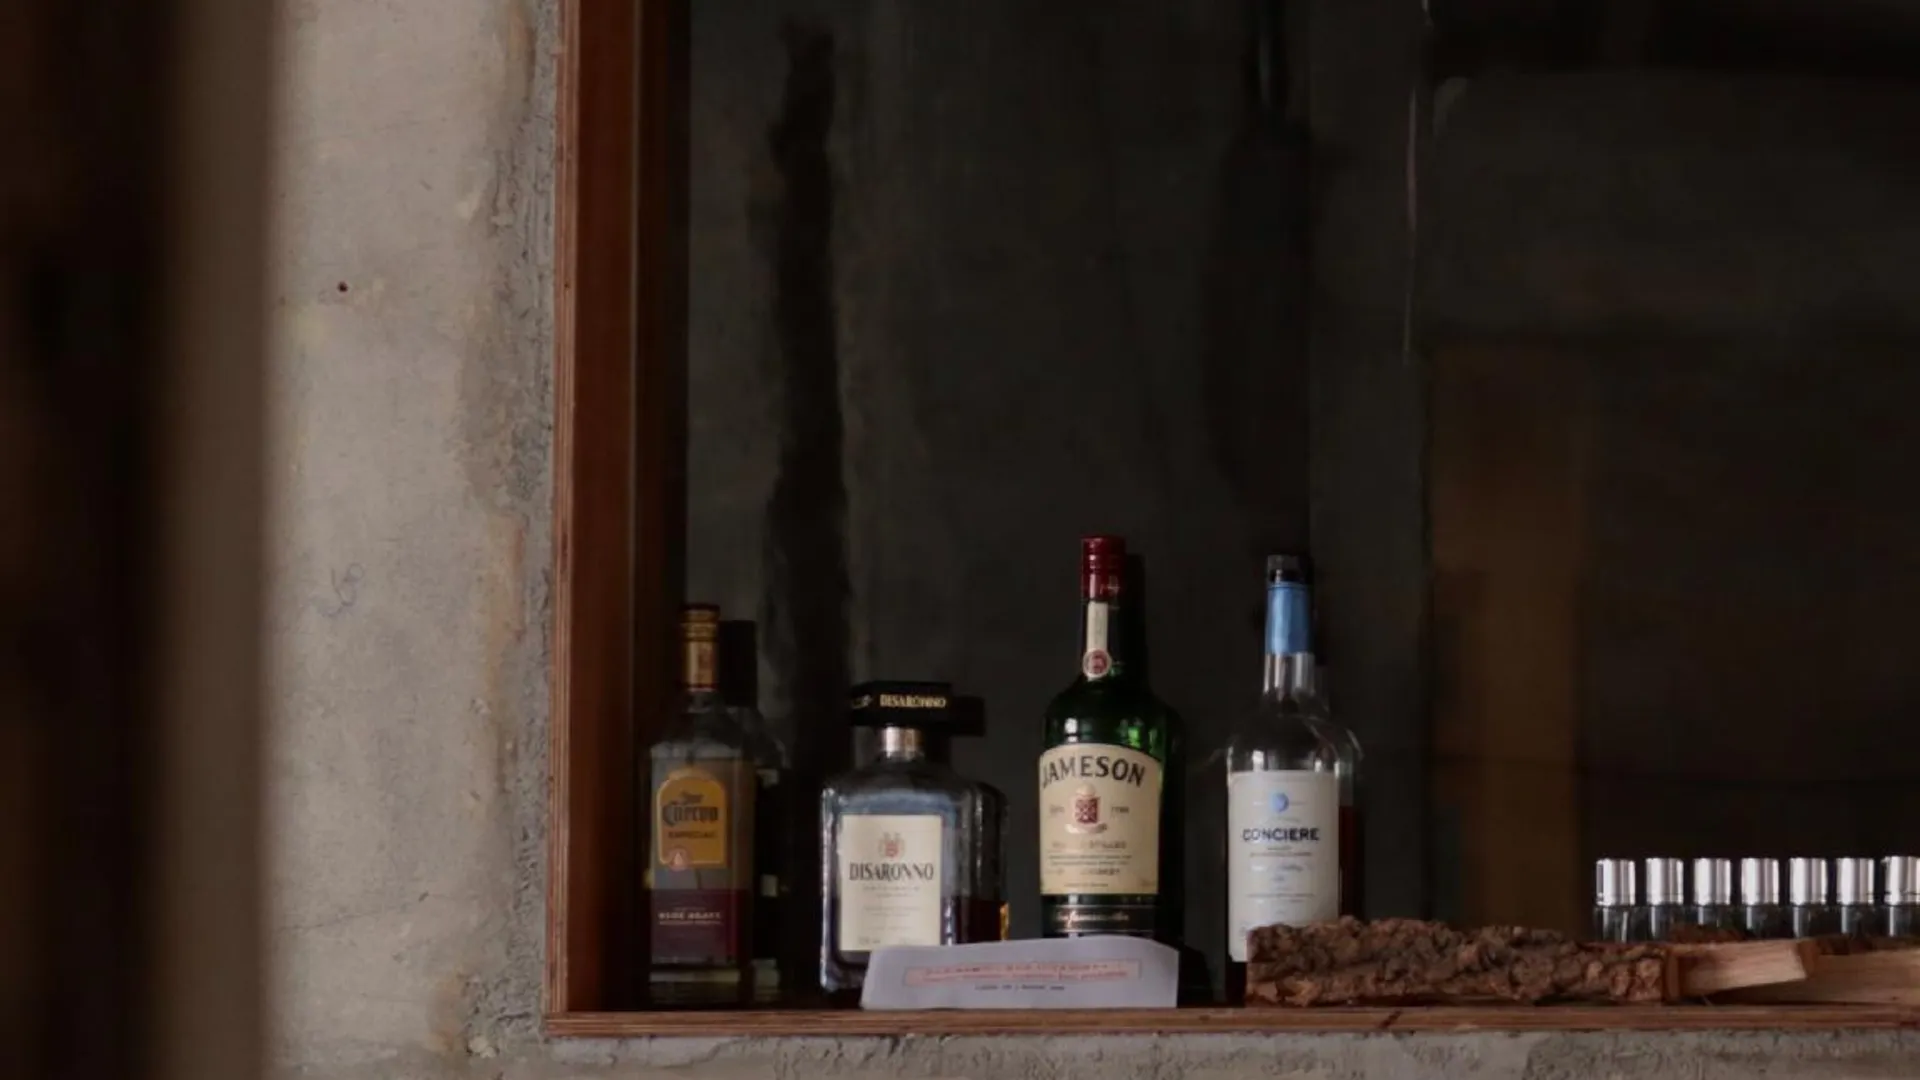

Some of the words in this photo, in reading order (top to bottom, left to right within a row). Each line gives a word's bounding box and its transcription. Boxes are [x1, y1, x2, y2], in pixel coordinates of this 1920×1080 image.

[879, 693, 947, 709] DISARONNO
[1041, 754, 1146, 789] JAMESON
[1241, 827, 1320, 842] CONCIERE
[848, 861, 934, 884] DISARONNO
